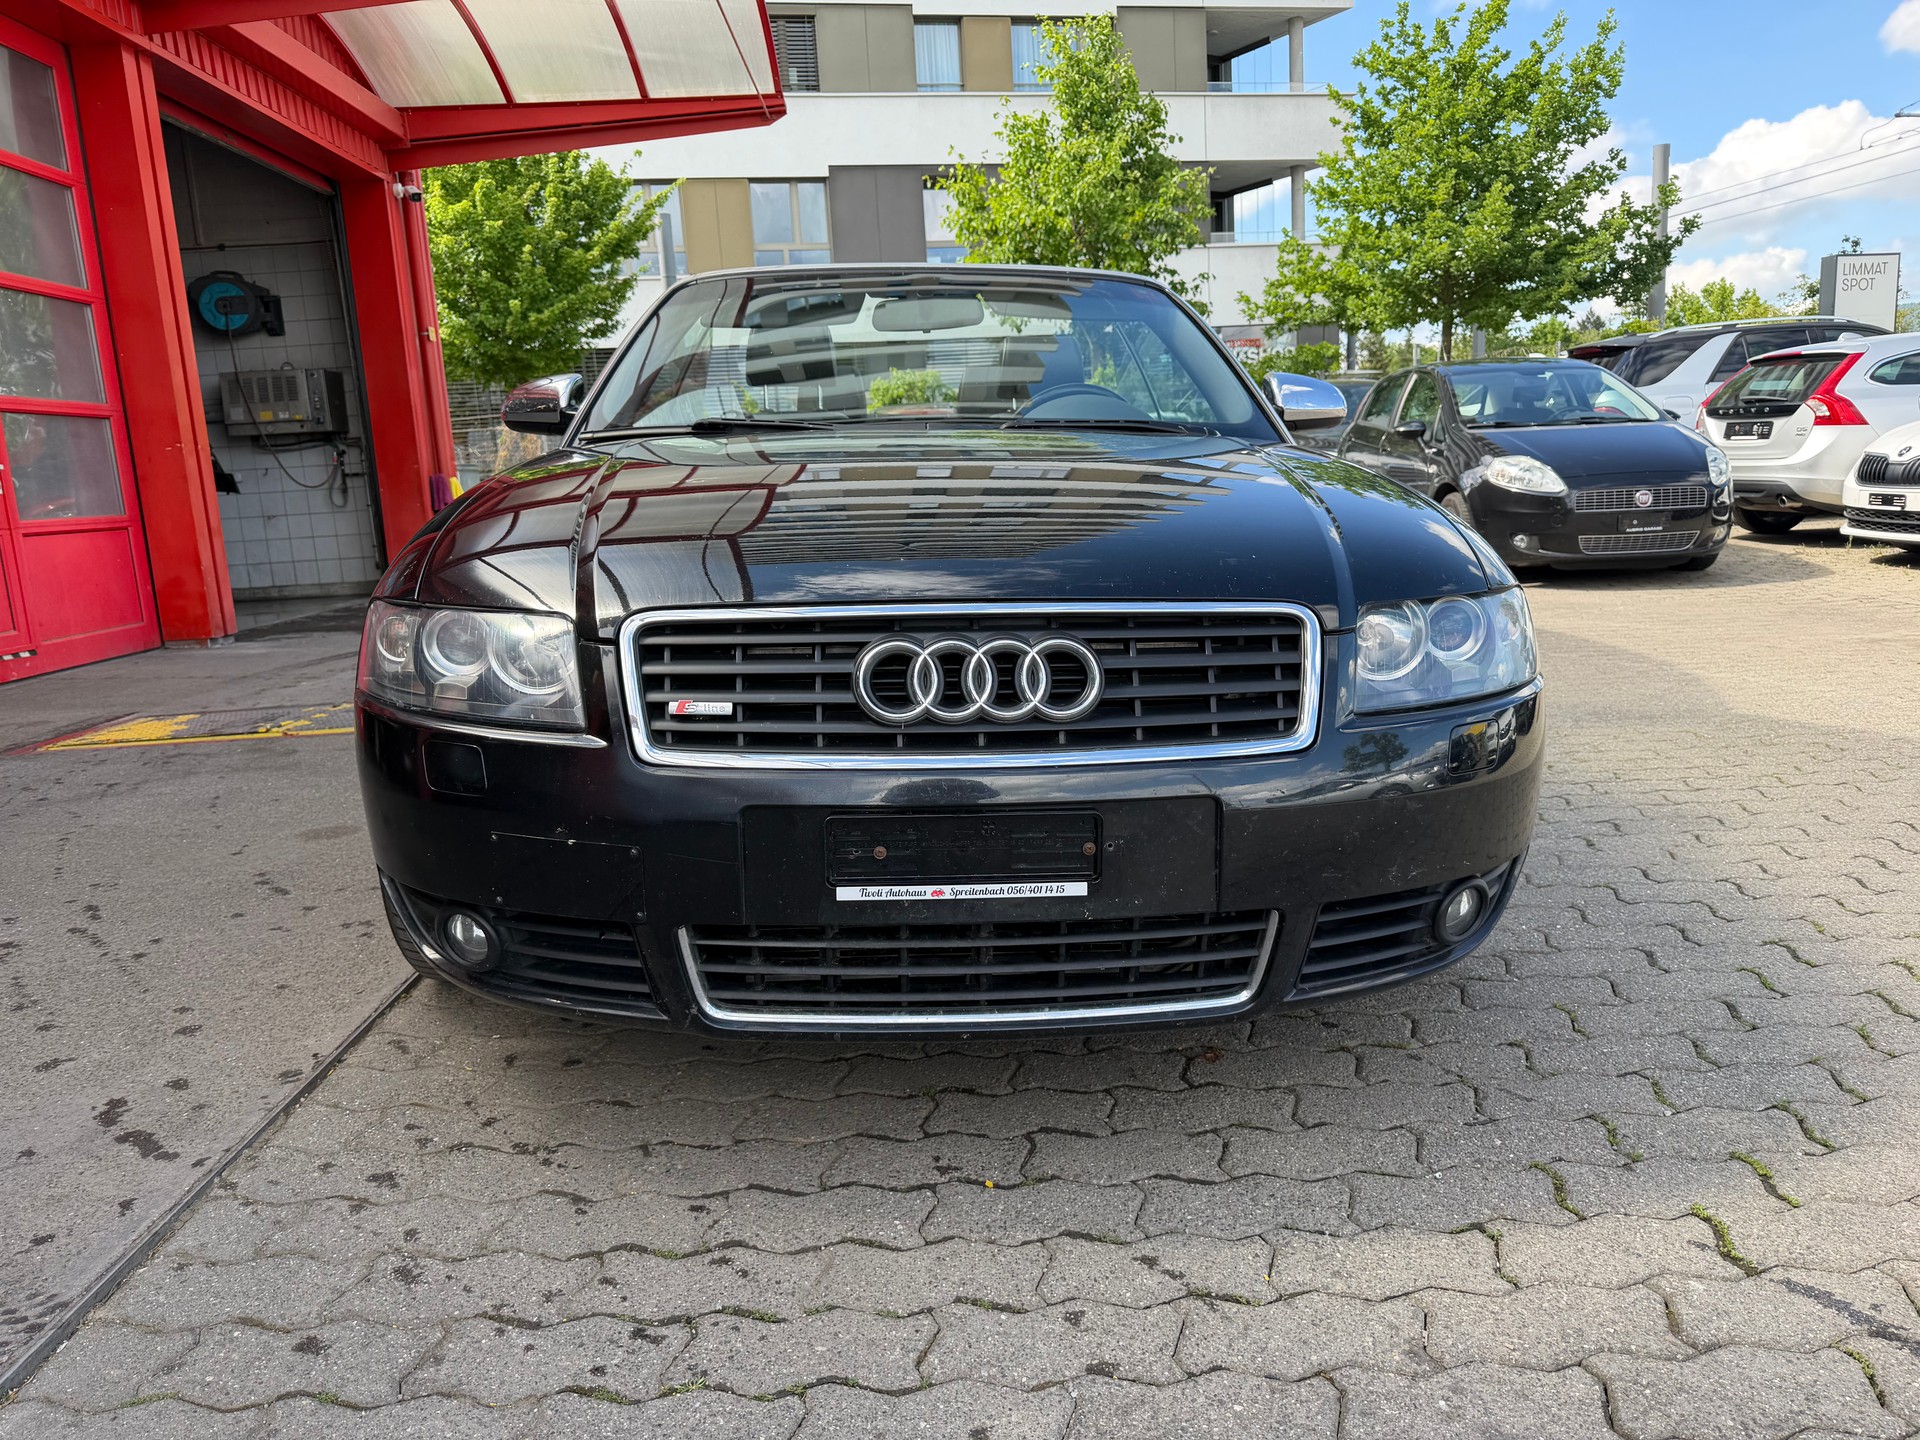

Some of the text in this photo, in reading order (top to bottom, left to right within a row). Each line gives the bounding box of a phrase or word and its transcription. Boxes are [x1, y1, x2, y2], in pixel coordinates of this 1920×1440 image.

[1842, 261, 1889, 276] LIMMAT
[1841, 277, 1876, 292] SPOT
[703, 703, 726, 713] line
[859, 887, 884, 898] Tivoli
[885, 887, 927, 899] Autohaus
[949, 886, 1005, 899] Spreitenbach
[1055, 884, 1066, 895] 15
